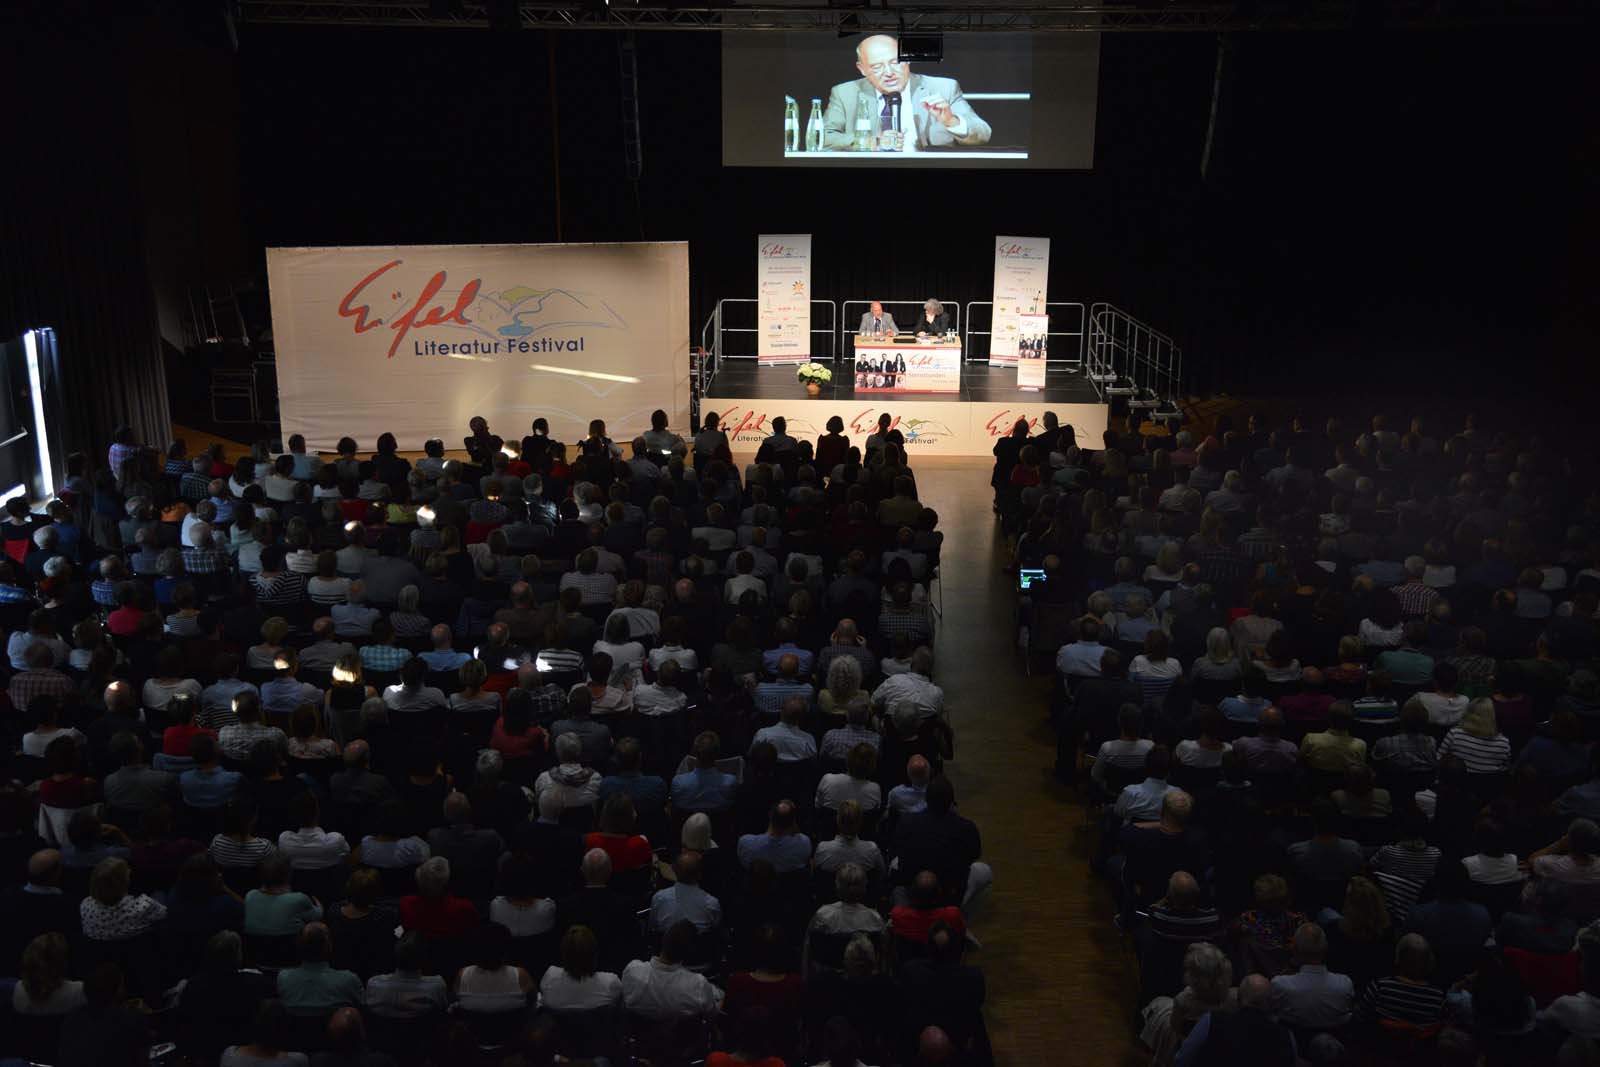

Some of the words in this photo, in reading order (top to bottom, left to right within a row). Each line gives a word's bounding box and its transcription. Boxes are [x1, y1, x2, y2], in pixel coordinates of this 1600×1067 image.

[339, 260, 481, 358] Eifel
[415, 339, 500, 355] Literatur
[508, 337, 584, 353] Festival
